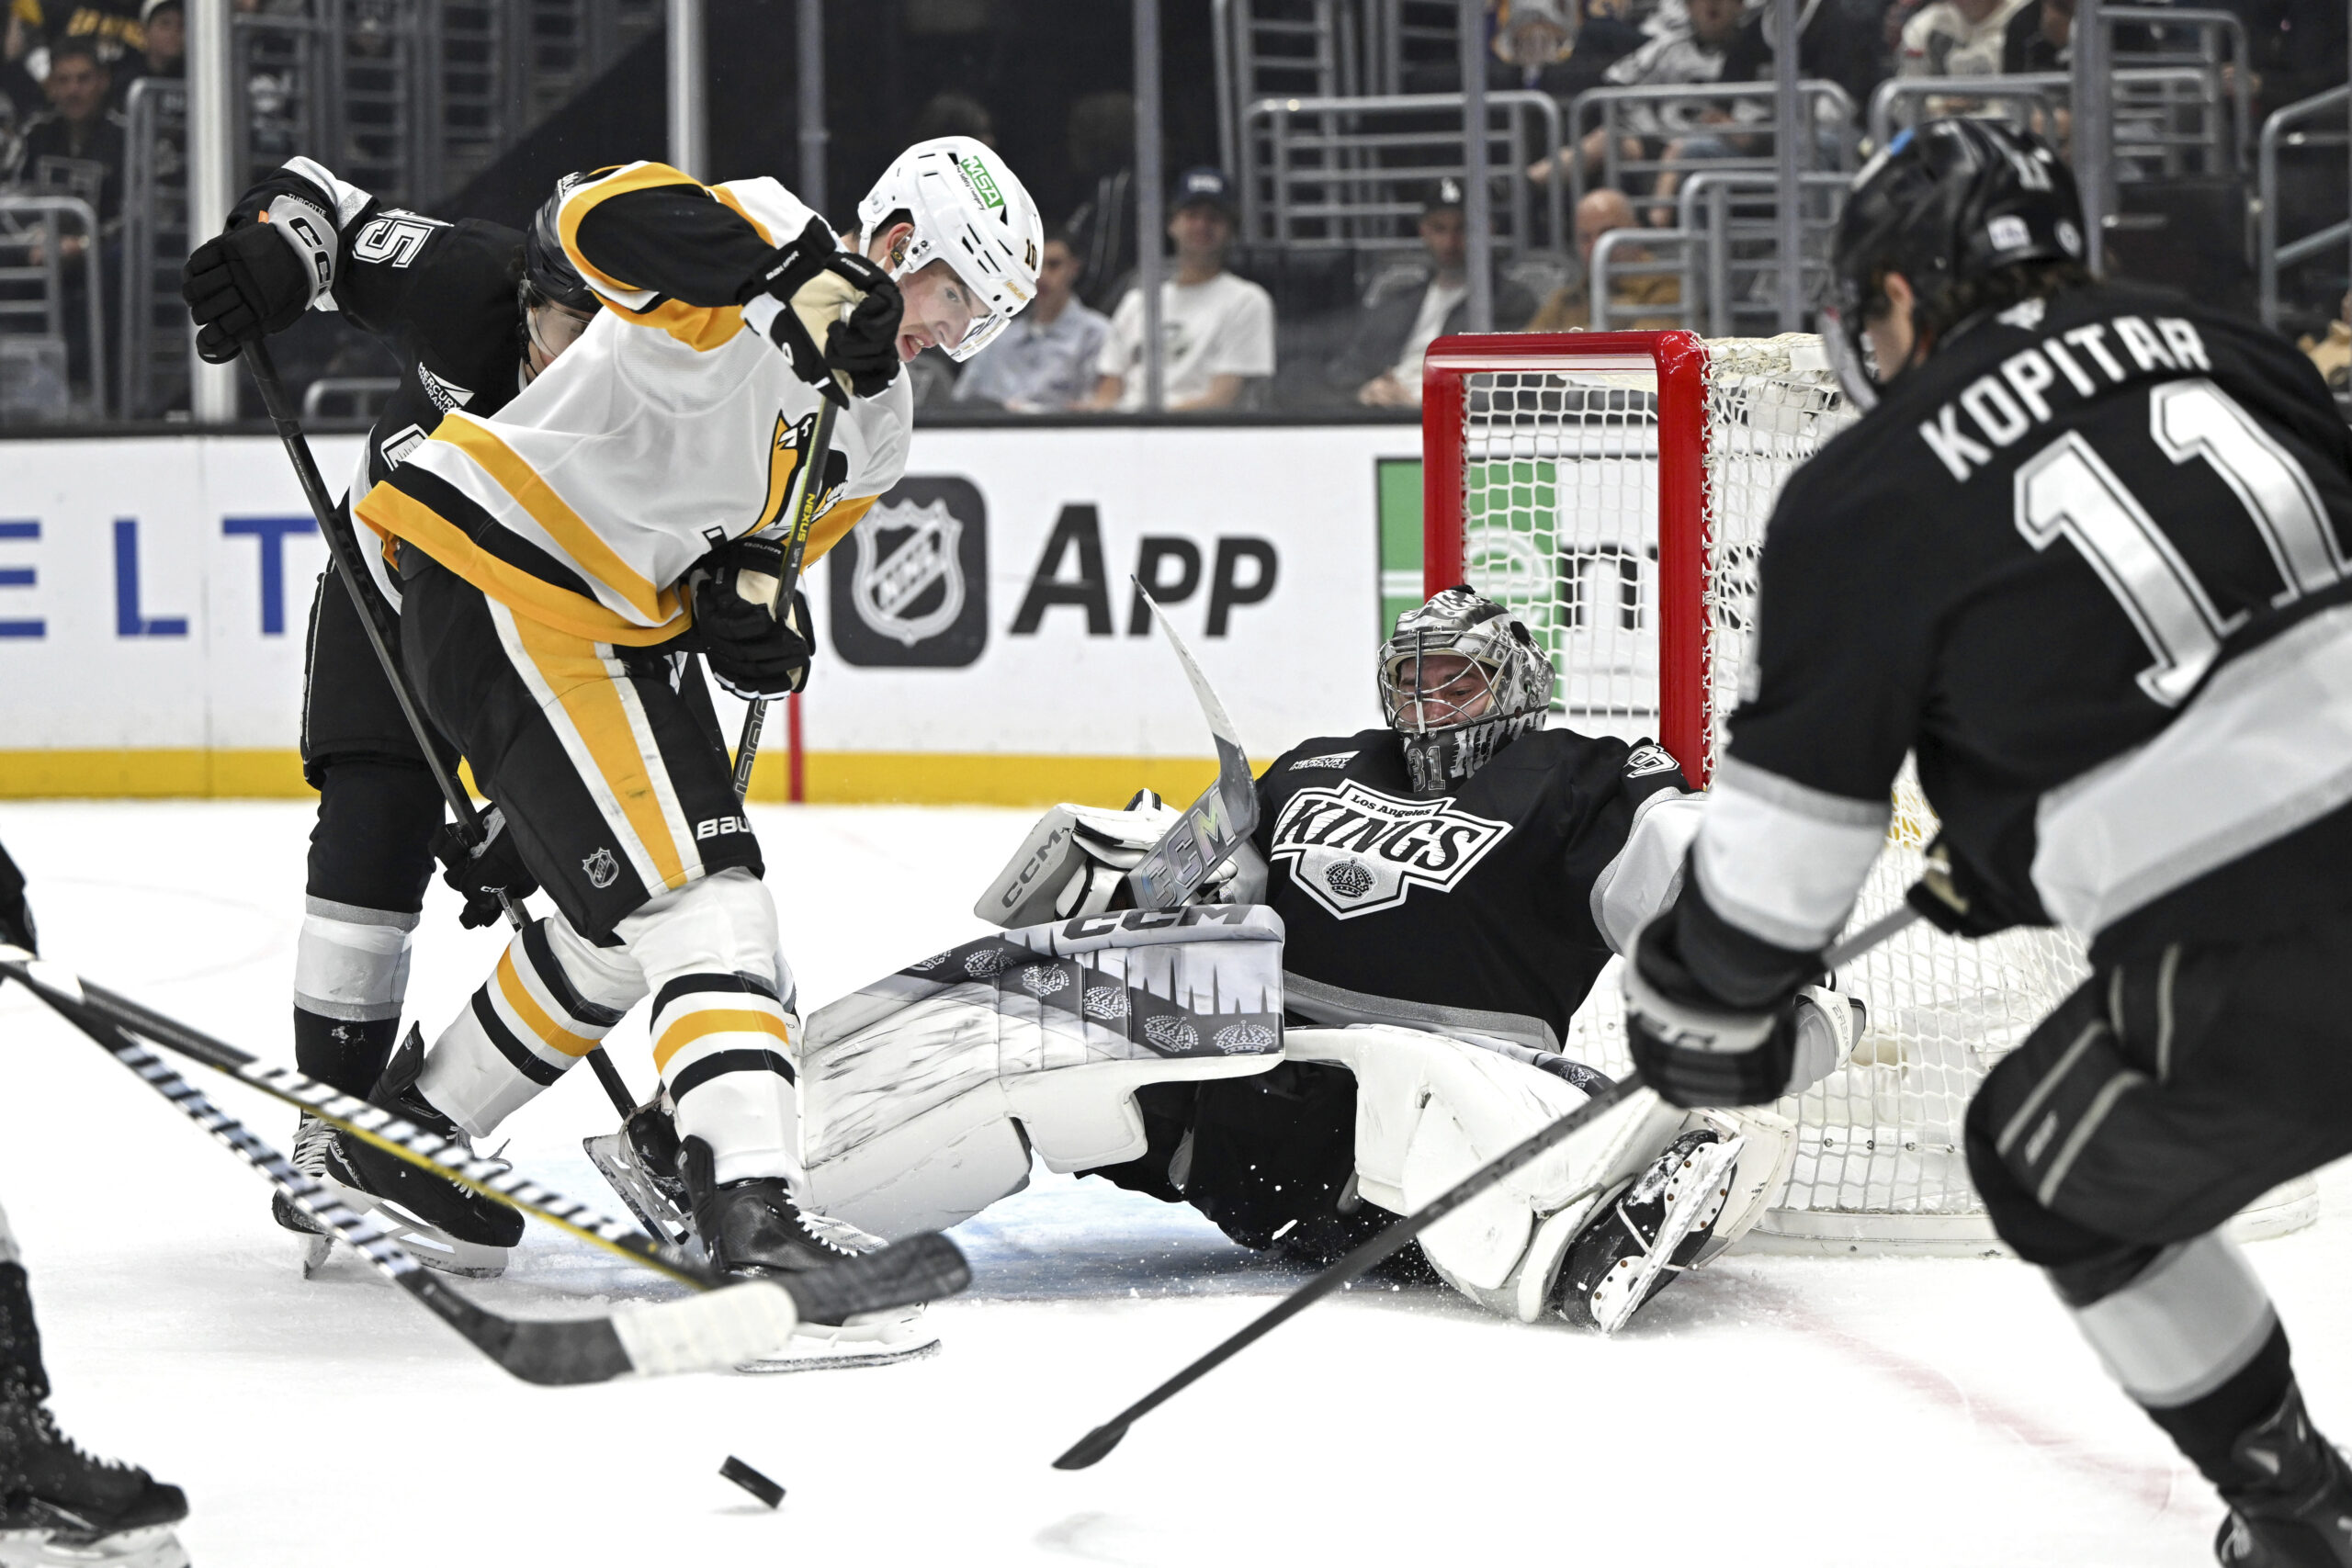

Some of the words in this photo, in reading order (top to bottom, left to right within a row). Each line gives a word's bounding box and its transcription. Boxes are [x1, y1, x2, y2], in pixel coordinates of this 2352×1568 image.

[288, 193, 327, 219] TURCOTTE
[962, 157, 1002, 207] MSA
[288, 216, 333, 296] CC
[1024, 238, 1037, 272] 10
[418, 369, 448, 416] INSURANC
[1918, 314, 2211, 483] KOPITAR
[797, 492, 817, 543] NEXUS
[2013, 377, 2352, 708] 11
[0, 517, 319, 637] ELT
[1407, 745, 1446, 794] 31
[696, 816, 751, 840] BAU
[1350, 794, 1376, 810] Los
[1376, 805, 1432, 818] Angeles
[1141, 787, 1237, 908] CCM
[1272, 799, 1482, 872] KINGS
[480, 885, 507, 894] CC
[1001, 829, 1062, 908] CCM
[1062, 904, 1251, 941] CCM
